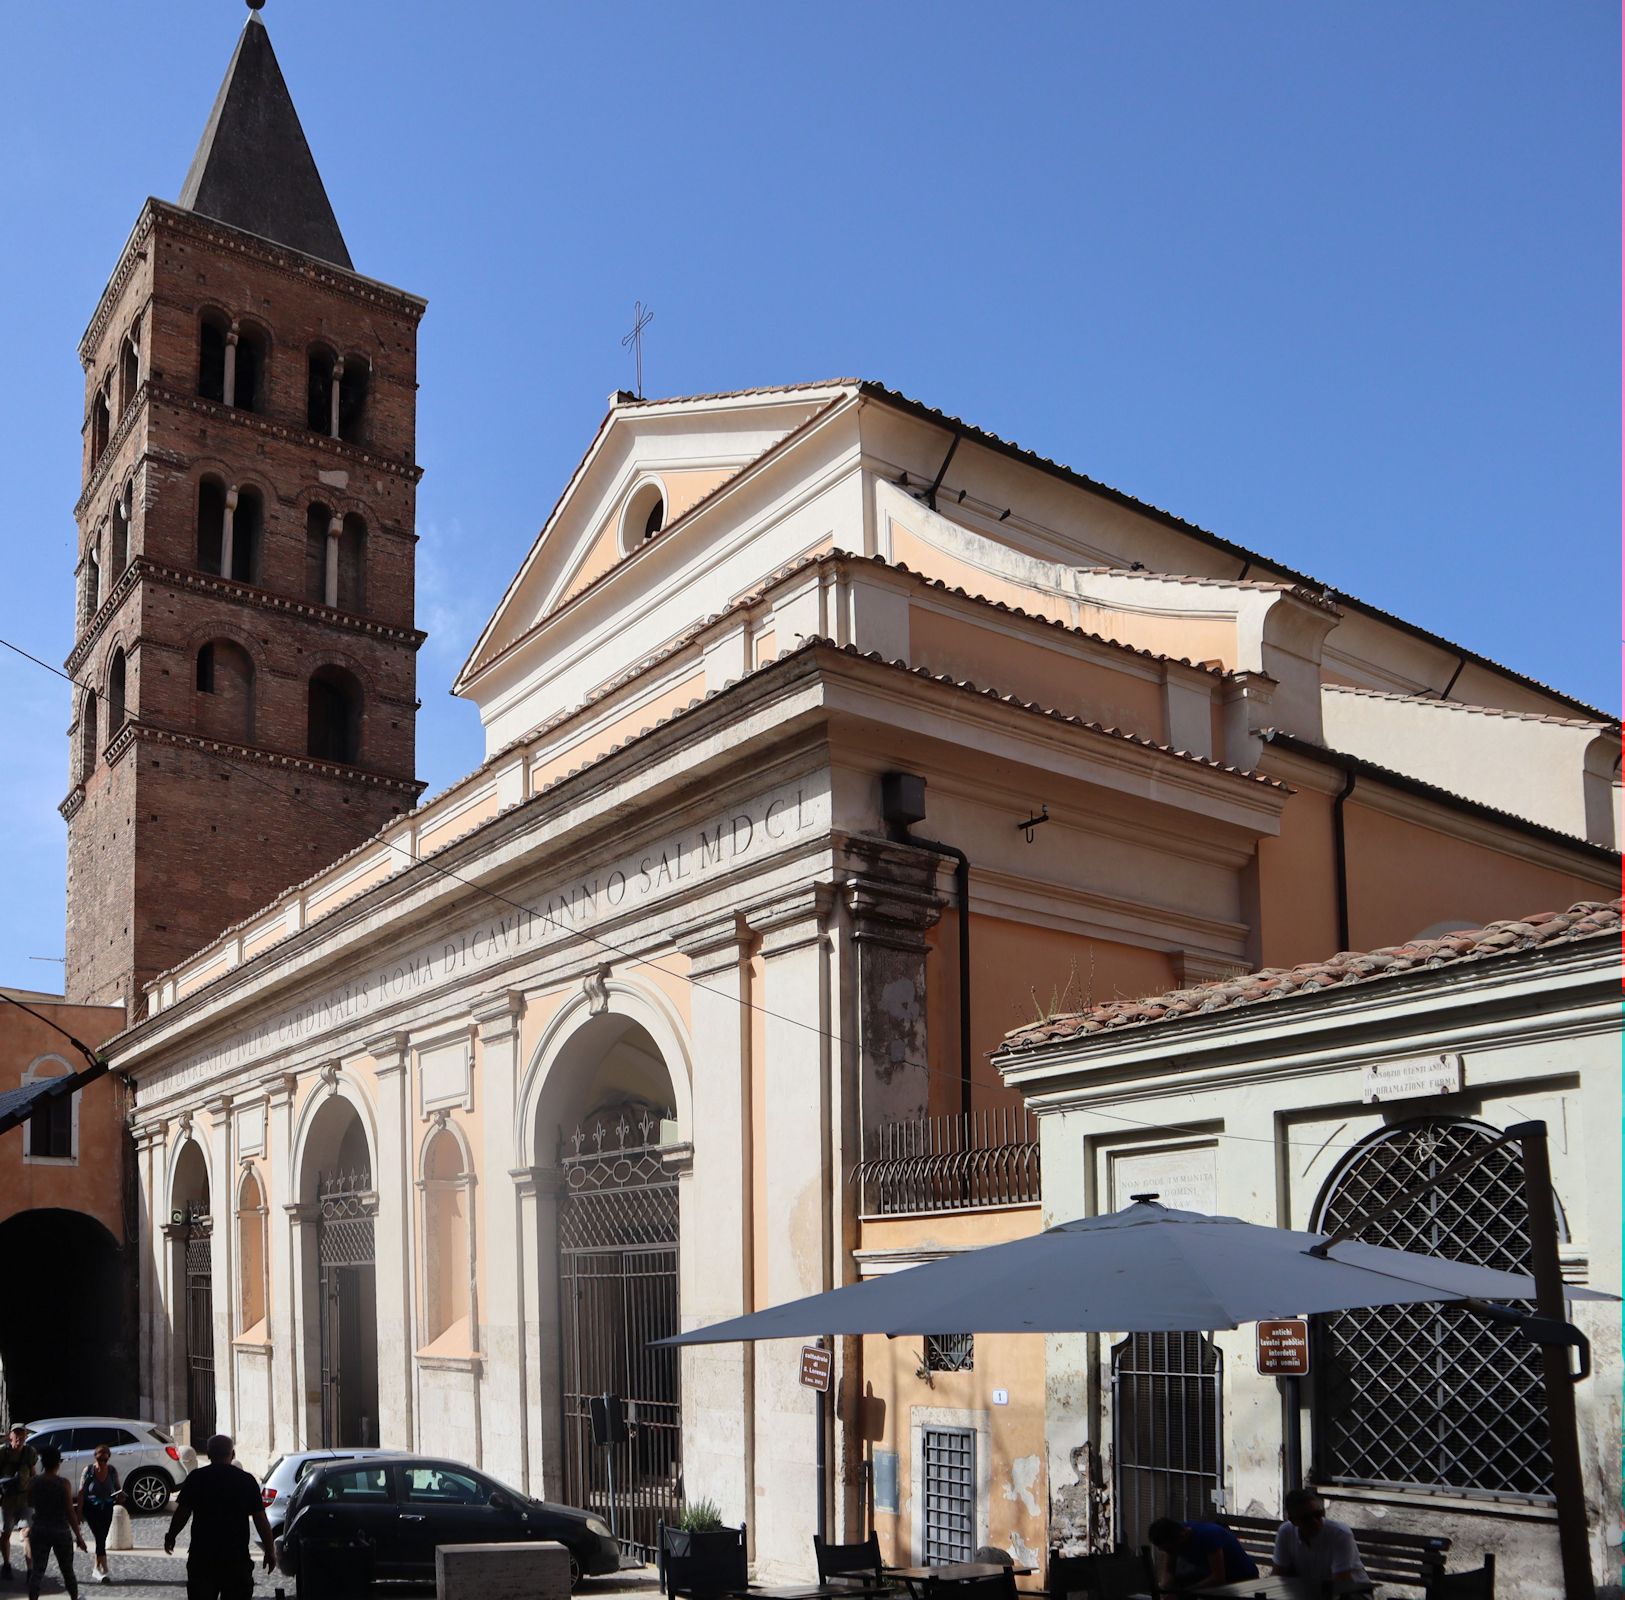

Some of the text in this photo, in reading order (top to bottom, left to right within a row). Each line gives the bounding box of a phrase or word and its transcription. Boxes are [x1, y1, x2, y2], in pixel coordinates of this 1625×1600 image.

[279, 982, 369, 1042] CARDINALIS
[379, 955, 433, 1001] ROMA
[444, 906, 538, 974] DICAVIT
[542, 870, 625, 935] ANNO
[1271, 1328, 1293, 1336] antichi
[1281, 1338, 1305, 1347] pubblici
[1268, 1349, 1297, 1357] interdetti
[1265, 1358, 1301, 1368] agli uomini
